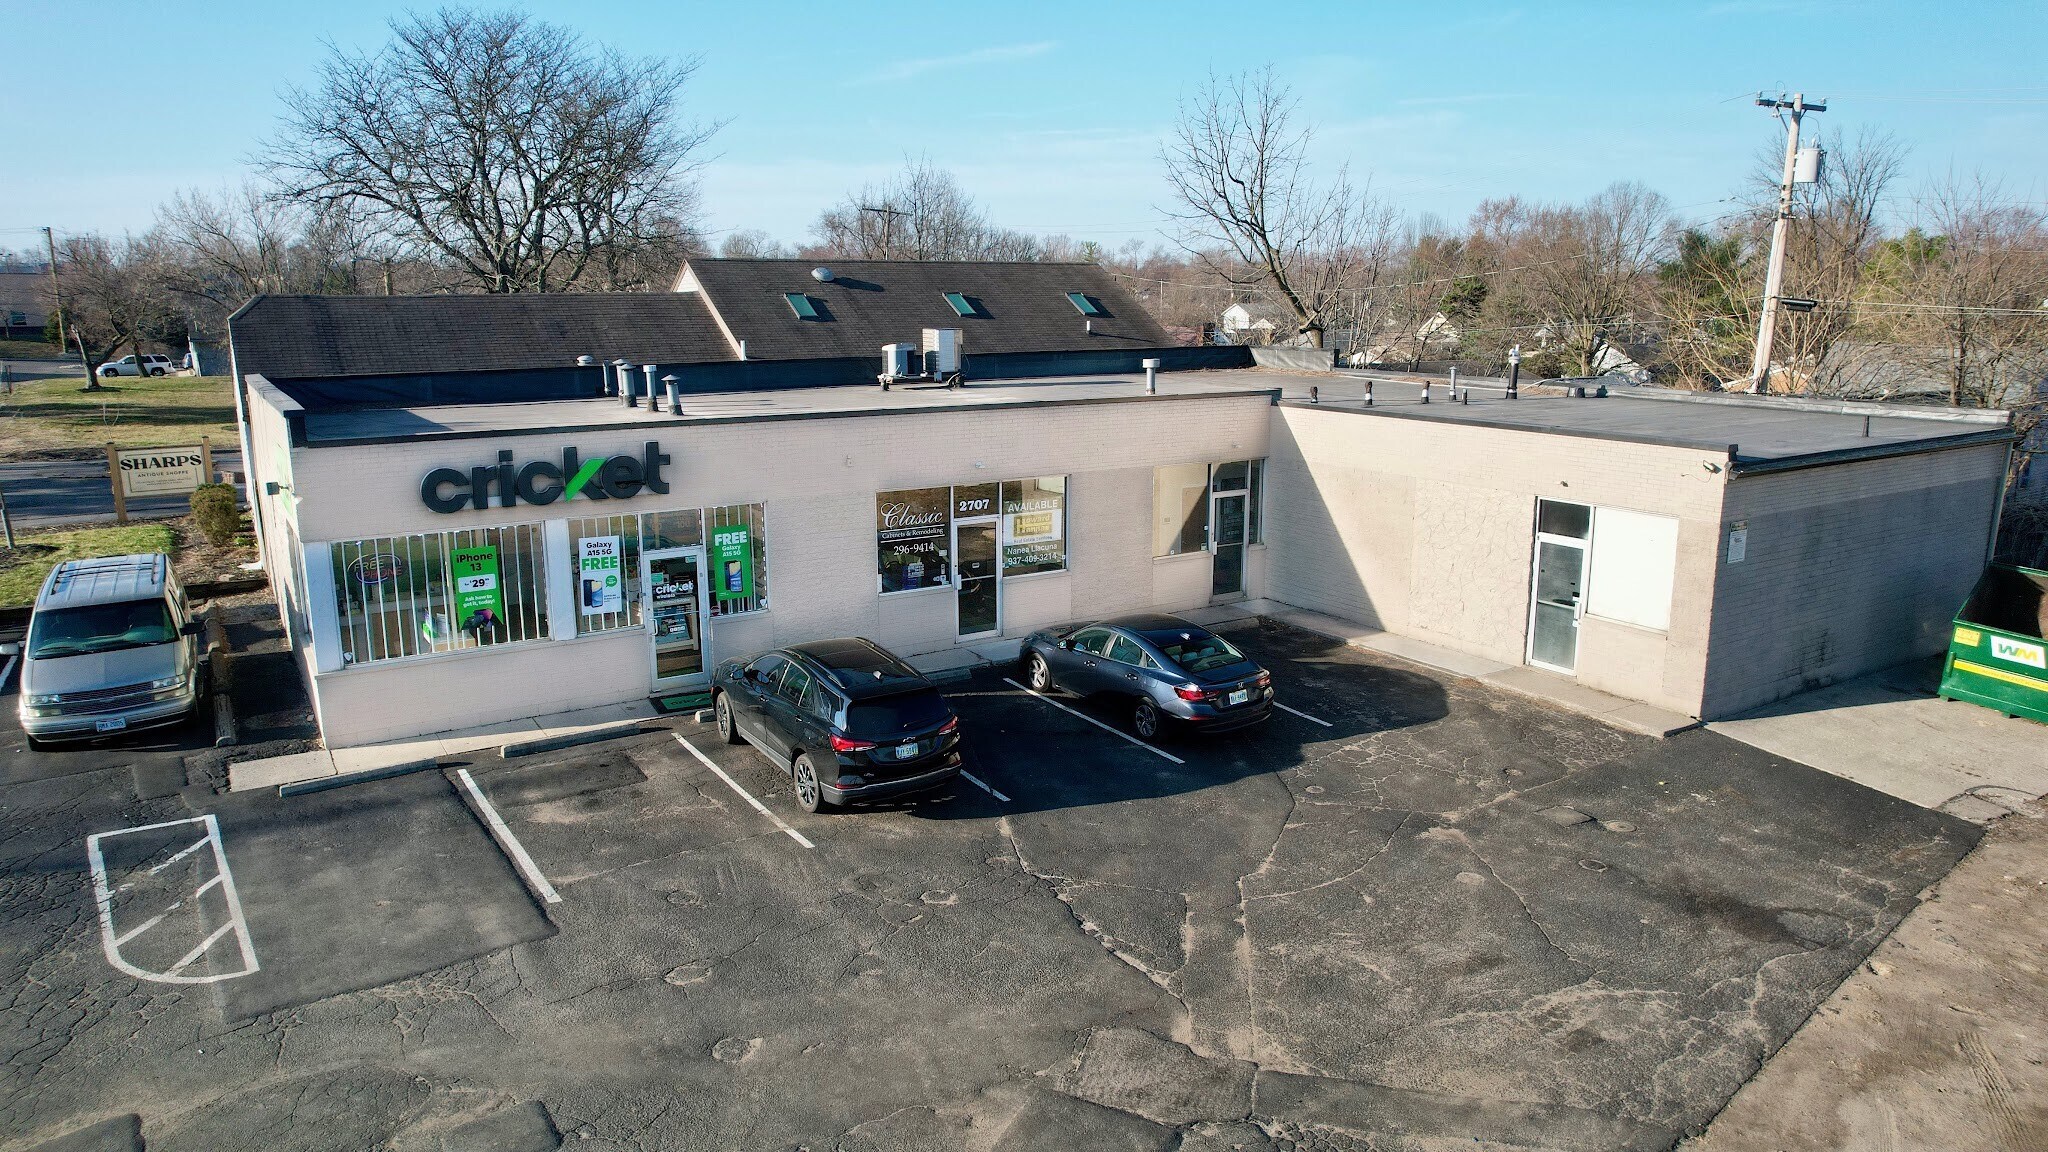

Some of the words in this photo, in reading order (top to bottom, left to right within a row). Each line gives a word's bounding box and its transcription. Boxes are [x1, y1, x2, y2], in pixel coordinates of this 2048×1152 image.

[120, 454, 202, 471] SHARPS
[420, 440, 671, 514] cricket
[959, 498, 990, 512] 2707
[1007, 499, 1059, 513] AVAILABLE
[880, 502, 943, 530] Classic
[714, 531, 748, 547] FREE
[881, 531, 906, 540] Cabinets
[912, 527, 944, 537] Remodeling
[586, 541, 613, 549] Galaxy
[1007, 547, 1030, 555] Nanea
[456, 553, 493, 564] iPhone
[581, 556, 618, 571] FREE
[1007, 551, 1058, 566] 937-409-3214
[470, 563, 482, 571] 13
[655, 580, 693, 594] cricket
[1998, 643, 2038, 662] WM
